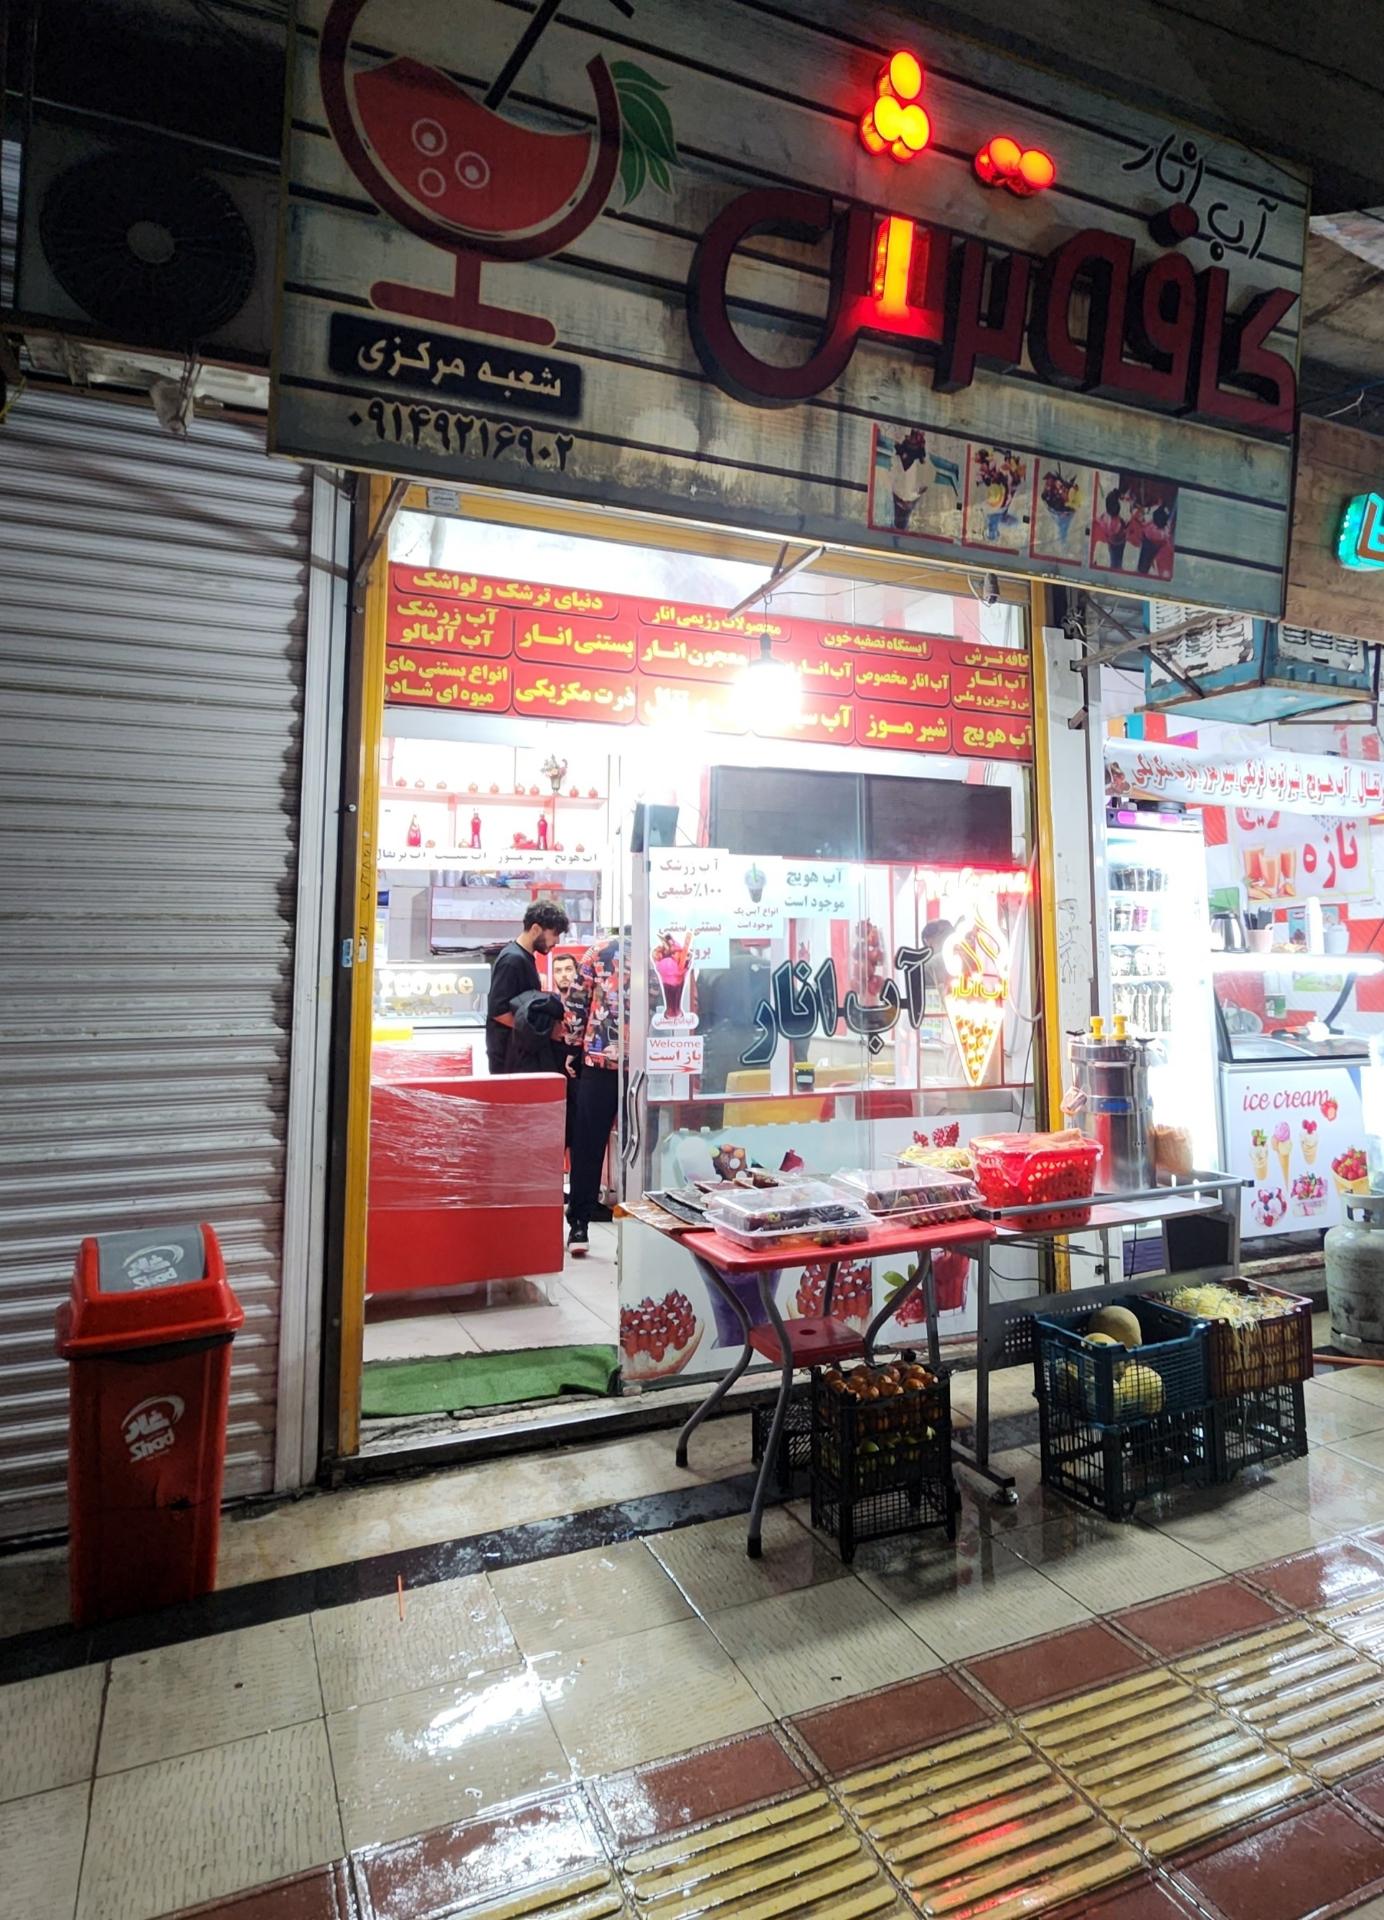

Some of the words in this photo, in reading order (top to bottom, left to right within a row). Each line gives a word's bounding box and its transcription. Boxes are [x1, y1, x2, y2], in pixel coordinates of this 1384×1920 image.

[1122, 133, 1207, 204] انار
[1209, 195, 1279, 263] آب
[1030, 201, 1301, 433] کافه
[357, 336, 466, 386] مرکزی
[477, 361, 562, 399] شعبه
[413, 571, 478, 596] لواشک
[483, 585, 493, 600] و
[496, 583, 551, 606] ترشک
[554, 591, 603, 611] دنیای
[397, 601, 462, 627] زرشک
[465, 608, 499, 625] آب
[651, 606, 676, 624] انار
[676, 612, 721, 631] رژیمی
[400, 624, 458, 643] آلبالو
[518, 623, 573, 648] انار
[721, 616, 782, 636] محصولات
[460, 630, 495, 648] آب
[574, 635, 635, 655] بستنی
[823, 631, 853, 649] خون
[886, 636, 928, 655] ایستگاه
[641, 639, 687, 662] انار
[687, 648, 748, 669] معجون
[965, 647, 1004, 667] ترش
[1004, 650, 1030, 668] کافه
[384, 655, 415, 675] های
[418, 661, 465, 679] بستنی
[468, 664, 508, 685] انواع
[829, 662, 853, 680] آب
[855, 669, 909, 687] مخصوص
[908, 673, 930, 691] انار
[929, 674, 950, 690] آب
[966, 670, 1003, 689] انار
[1003, 674, 1029, 692] آب
[390, 679, 434, 698] شاد
[436, 684, 458, 703] ای
[515, 678, 591, 707] مکزیکی
[593, 684, 636, 711] ذرت
[459, 691, 494, 707] میوه
[976, 695, 983, 706] و
[982, 693, 1010, 708] شیرین
[821, 704, 853, 733] آب
[864, 715, 914, 739] موز
[916, 717, 949, 743] شیر
[963, 725, 1007, 749] هویج
[1009, 724, 1033, 750] آب
[1303, 820, 1359, 889] تازه
[659, 858, 696, 875] زرشک
[786, 870, 819, 888] هویج
[823, 867, 842, 888] آب
[784, 896, 808, 908] است
[810, 896, 845, 912] موجود
[737, 921, 752, 930] است
[752, 921, 773, 931] موجود
[844, 946, 933, 1055] آب
[739, 957, 838, 1067] انار
[649, 1038, 702, 1048] Welcome
[649, 1049, 680, 1061] است
[683, 1049, 702, 1065] باز
[1242, 1085, 1270, 1111] ice
[1273, 1088, 1330, 1110] cream
